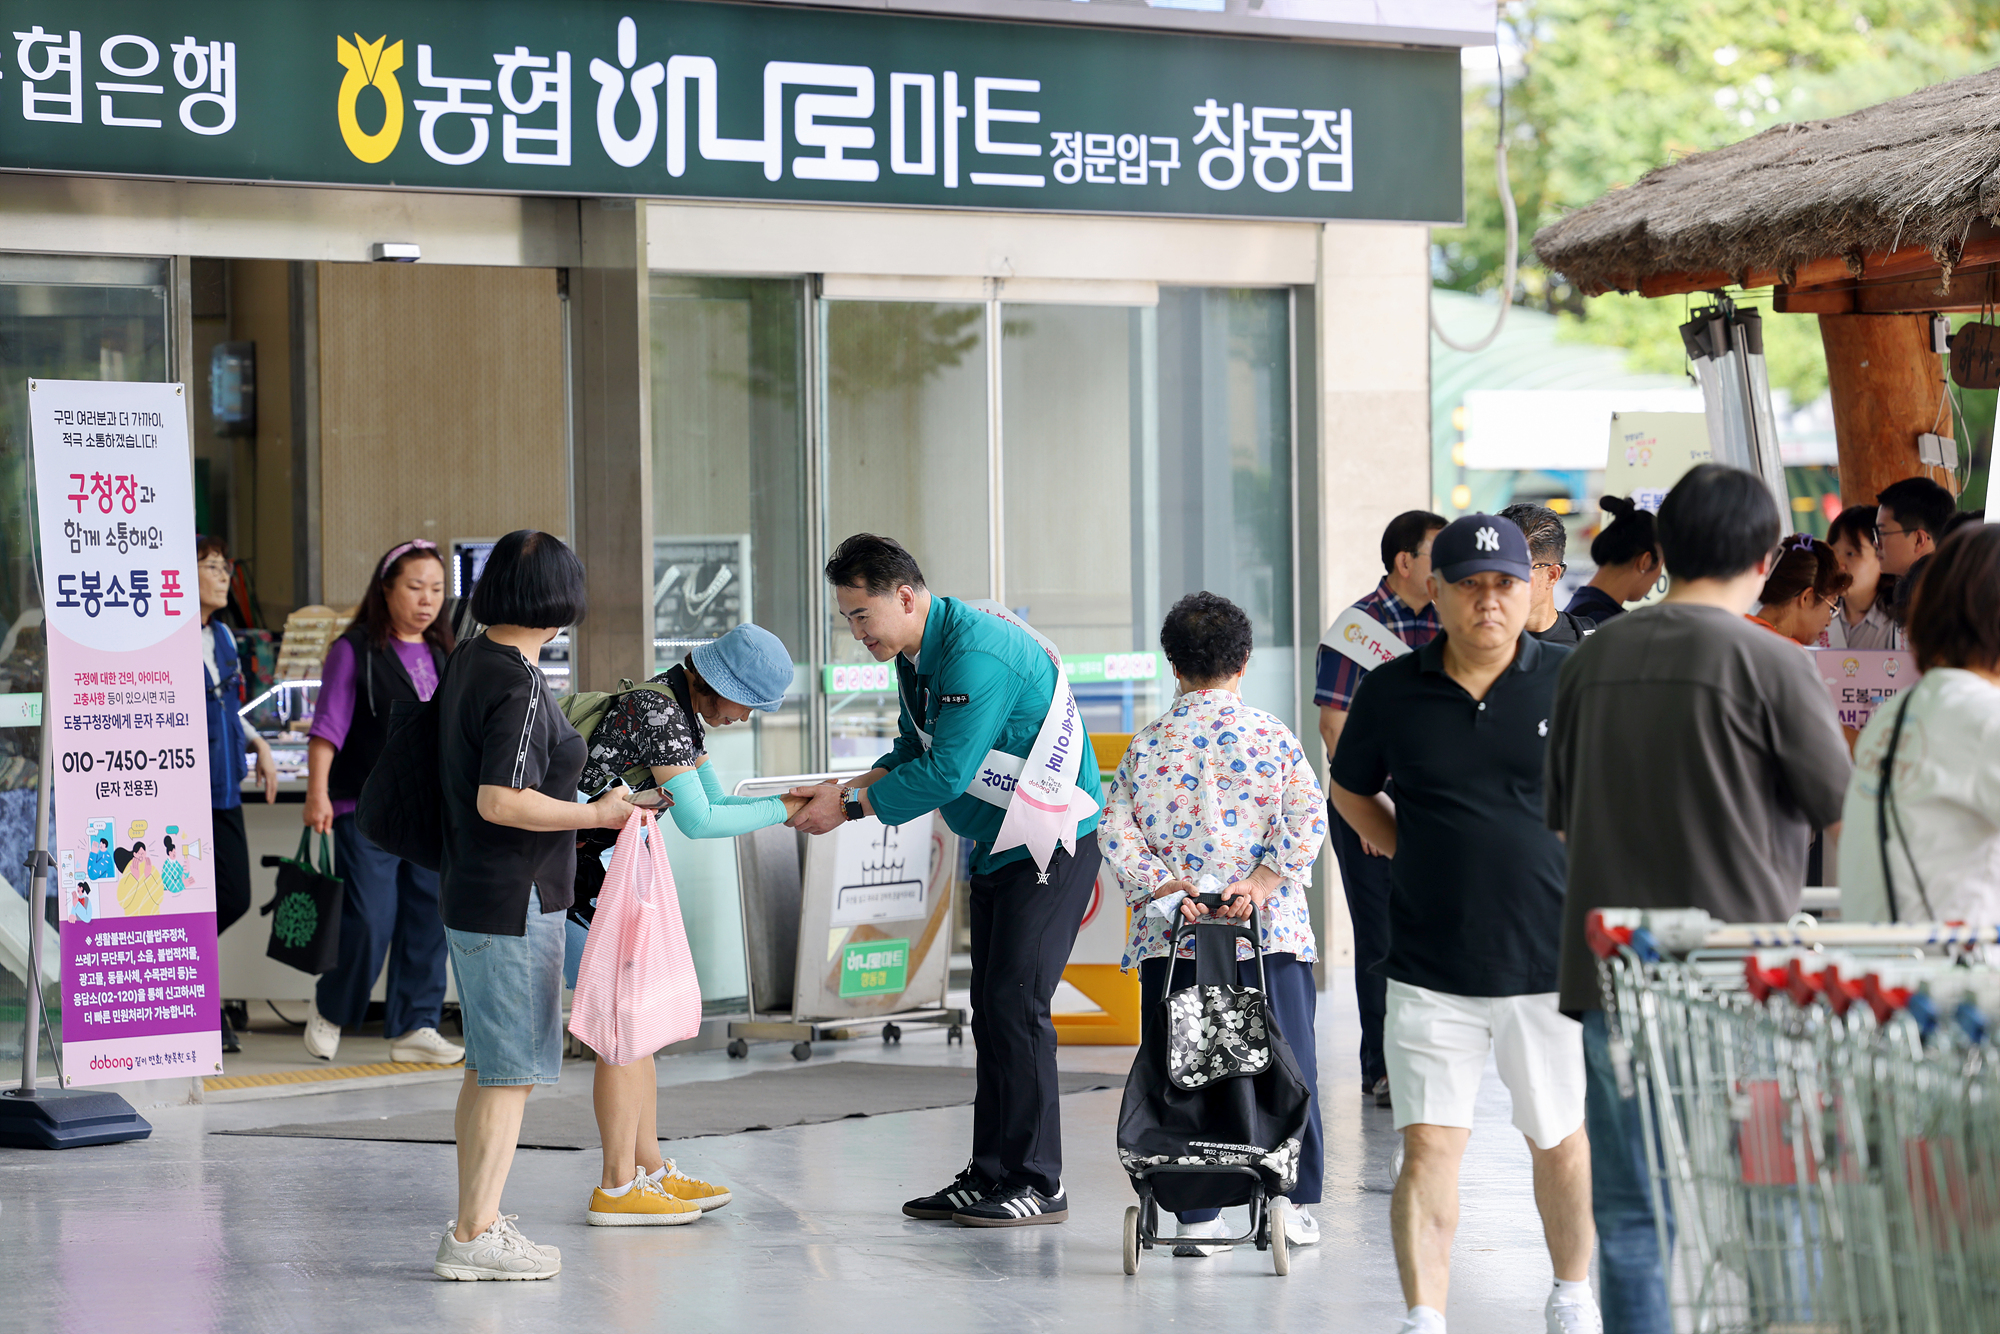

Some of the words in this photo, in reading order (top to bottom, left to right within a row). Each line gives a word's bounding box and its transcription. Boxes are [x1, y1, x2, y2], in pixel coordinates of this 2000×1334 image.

[0, 25, 237, 136] 협은행
[413, 44, 572, 166] 농협
[1049, 131, 1182, 187] 정문입구
[1192, 98, 1354, 193] 창동점
[54, 410, 74, 426] 구민
[76, 410, 117, 427] 여러분과
[119, 411, 129, 427] 더
[131, 411, 164, 429] 가까이,
[62, 432, 83, 448] 적극
[85, 432, 158, 449] 소통하겠습니다!
[68, 471, 156, 514] 구청장과
[64, 518, 101, 554] 함께
[106, 522, 163, 555] 소통해요!
[56, 570, 152, 618] 도봉소통
[160, 569, 184, 616] 폰
[74, 671, 99, 687] 구정에
[100, 671, 117, 686] 대한
[118, 671, 137, 687] 건의,
[138, 671, 173, 686] 아이디어,
[73, 692, 106, 706] 고충사항
[107, 691, 124, 706] 등이
[125, 691, 158, 705] 있으시면
[159, 690, 176, 704] 지금
[64, 713, 132, 731] 도봉구청장에게
[134, 713, 153, 729] 문자
[155, 712, 190, 729] 주세요!
[62, 748, 196, 773] 010-7450-2155
[95, 781, 121, 800] (문자
[123, 780, 159, 798] 전용폰)
[94, 928, 189, 947] 생활불편신고(불법주정차,
[75, 952, 100, 967] 쓰레기
[101, 950, 136, 966] 무단투기,
[137, 949, 157, 964] 소음,
[157, 946, 200, 962] 불법적치물,
[79, 972, 107, 987] 광고물,
[107, 969, 143, 985] 동물사체,
[144, 966, 176, 982] 수목관리
[177, 965, 198, 982] 등)는
[73, 987, 147, 1007] 응답소(02-120)을
[147, 986, 164, 1002] 통해
[165, 983, 206, 1000] 신고하시면
[84, 1011, 93, 1026] 더
[94, 1009, 111, 1025] 빠른
[112, 1006, 153, 1023] 민원처리가
[154, 1003, 197, 1020] 가능합니다.
[90, 1054, 133, 1071] dobong
